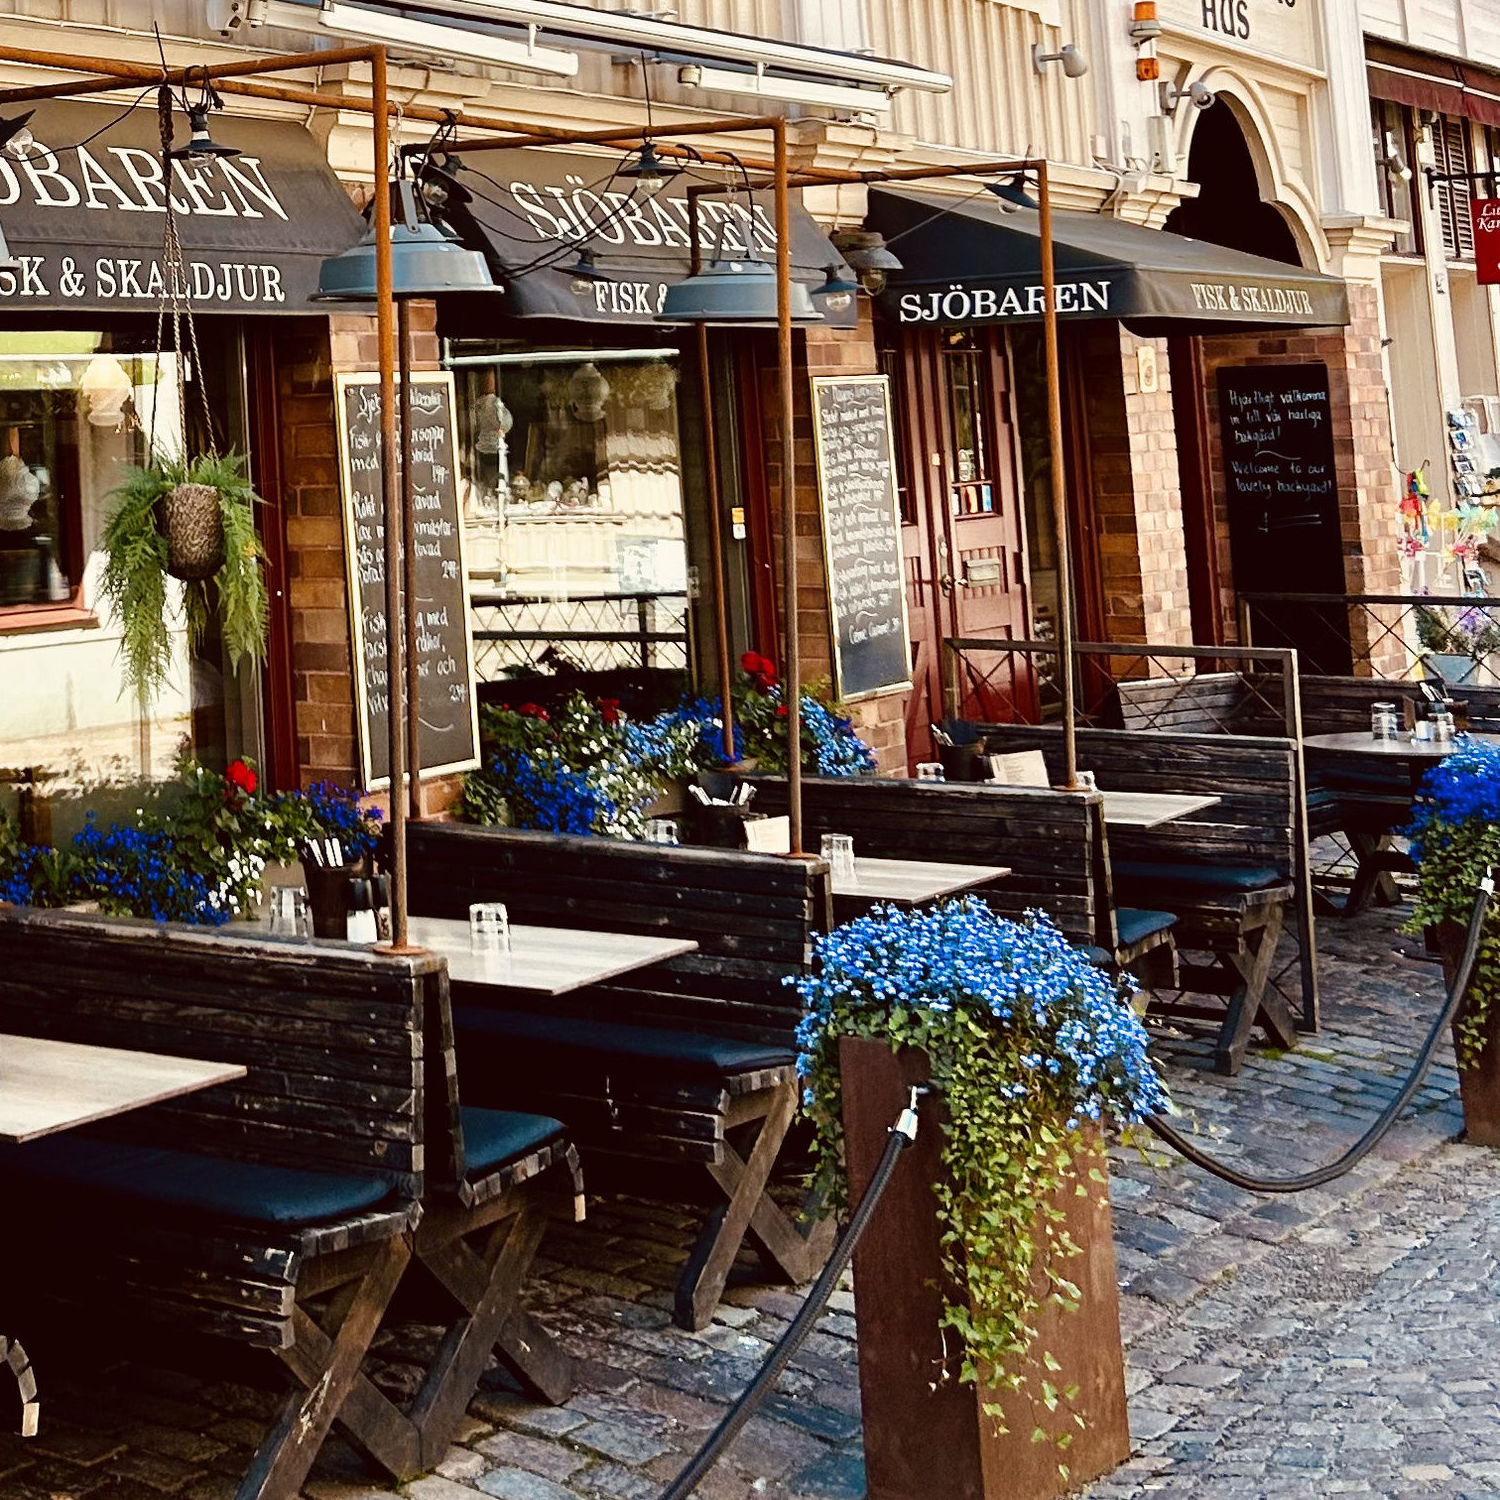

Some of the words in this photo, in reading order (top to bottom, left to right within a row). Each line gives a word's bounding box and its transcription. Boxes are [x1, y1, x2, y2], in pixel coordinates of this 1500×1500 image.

[509, 174, 792, 255] SJÖBAREN
[60, 256, 87, 297] &
[95, 257, 286, 303] SKALDJUR
[593, 280, 652, 315] FISK
[899, 281, 1112, 322] SJÖBAREN
[1190, 283, 1230, 311] FISK
[1228, 285, 1242, 311] &
[1241, 285, 1314, 315] SKALDJUR
[351, 452, 379, 472] med
[1231, 461, 1279, 475] Welcome
[1289, 463, 1302, 474] to
[437, 655, 456, 676] och
